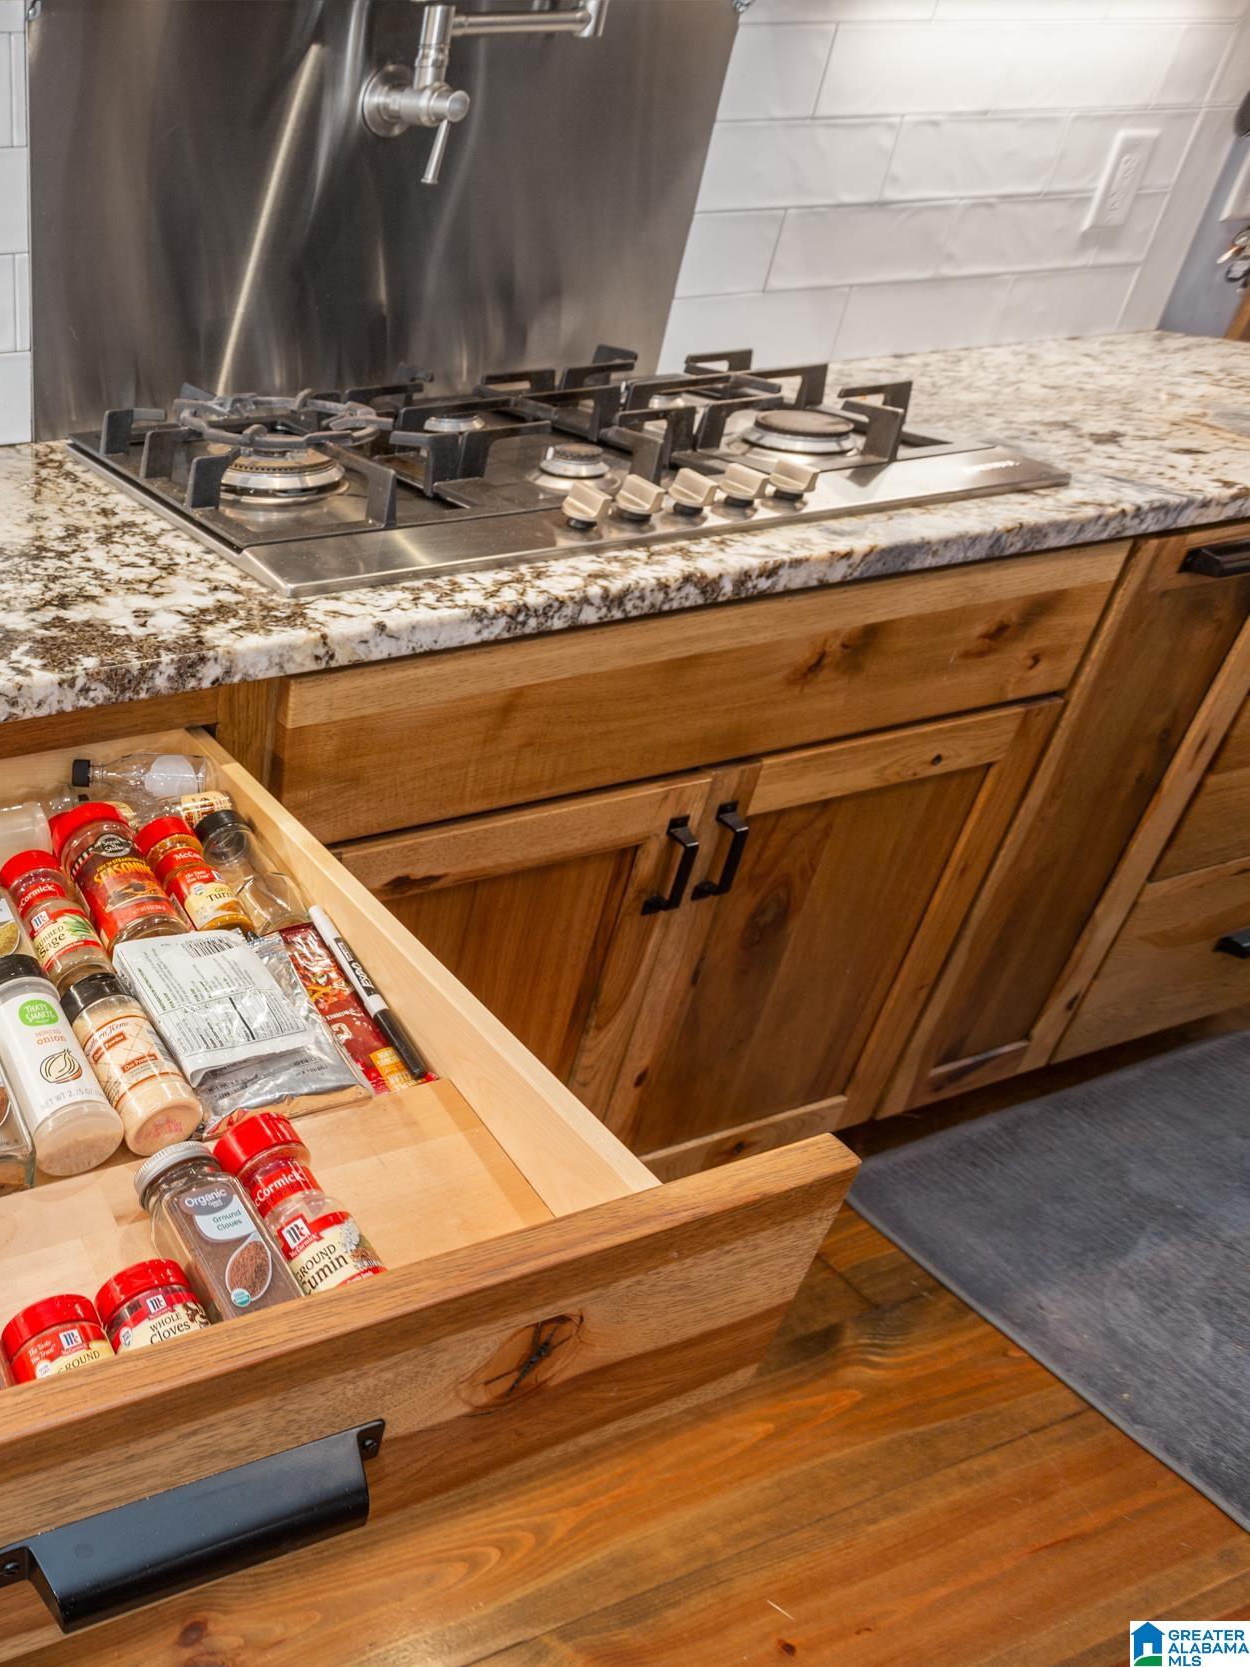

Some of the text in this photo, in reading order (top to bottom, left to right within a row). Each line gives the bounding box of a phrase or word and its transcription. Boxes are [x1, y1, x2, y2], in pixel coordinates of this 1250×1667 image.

[39, 933, 66, 959] Sage
[36, 1034, 67, 1046] onion
[184, 1188, 227, 1207] Organic
[212, 1209, 242, 1223] Ground
[216, 1219, 242, 1231] Cloves
[295, 1244, 337, 1280] GROUND
[301, 1254, 349, 1295] Cumin
[149, 1312, 182, 1332] WHOLE
[150, 1321, 191, 1344] Cloves
